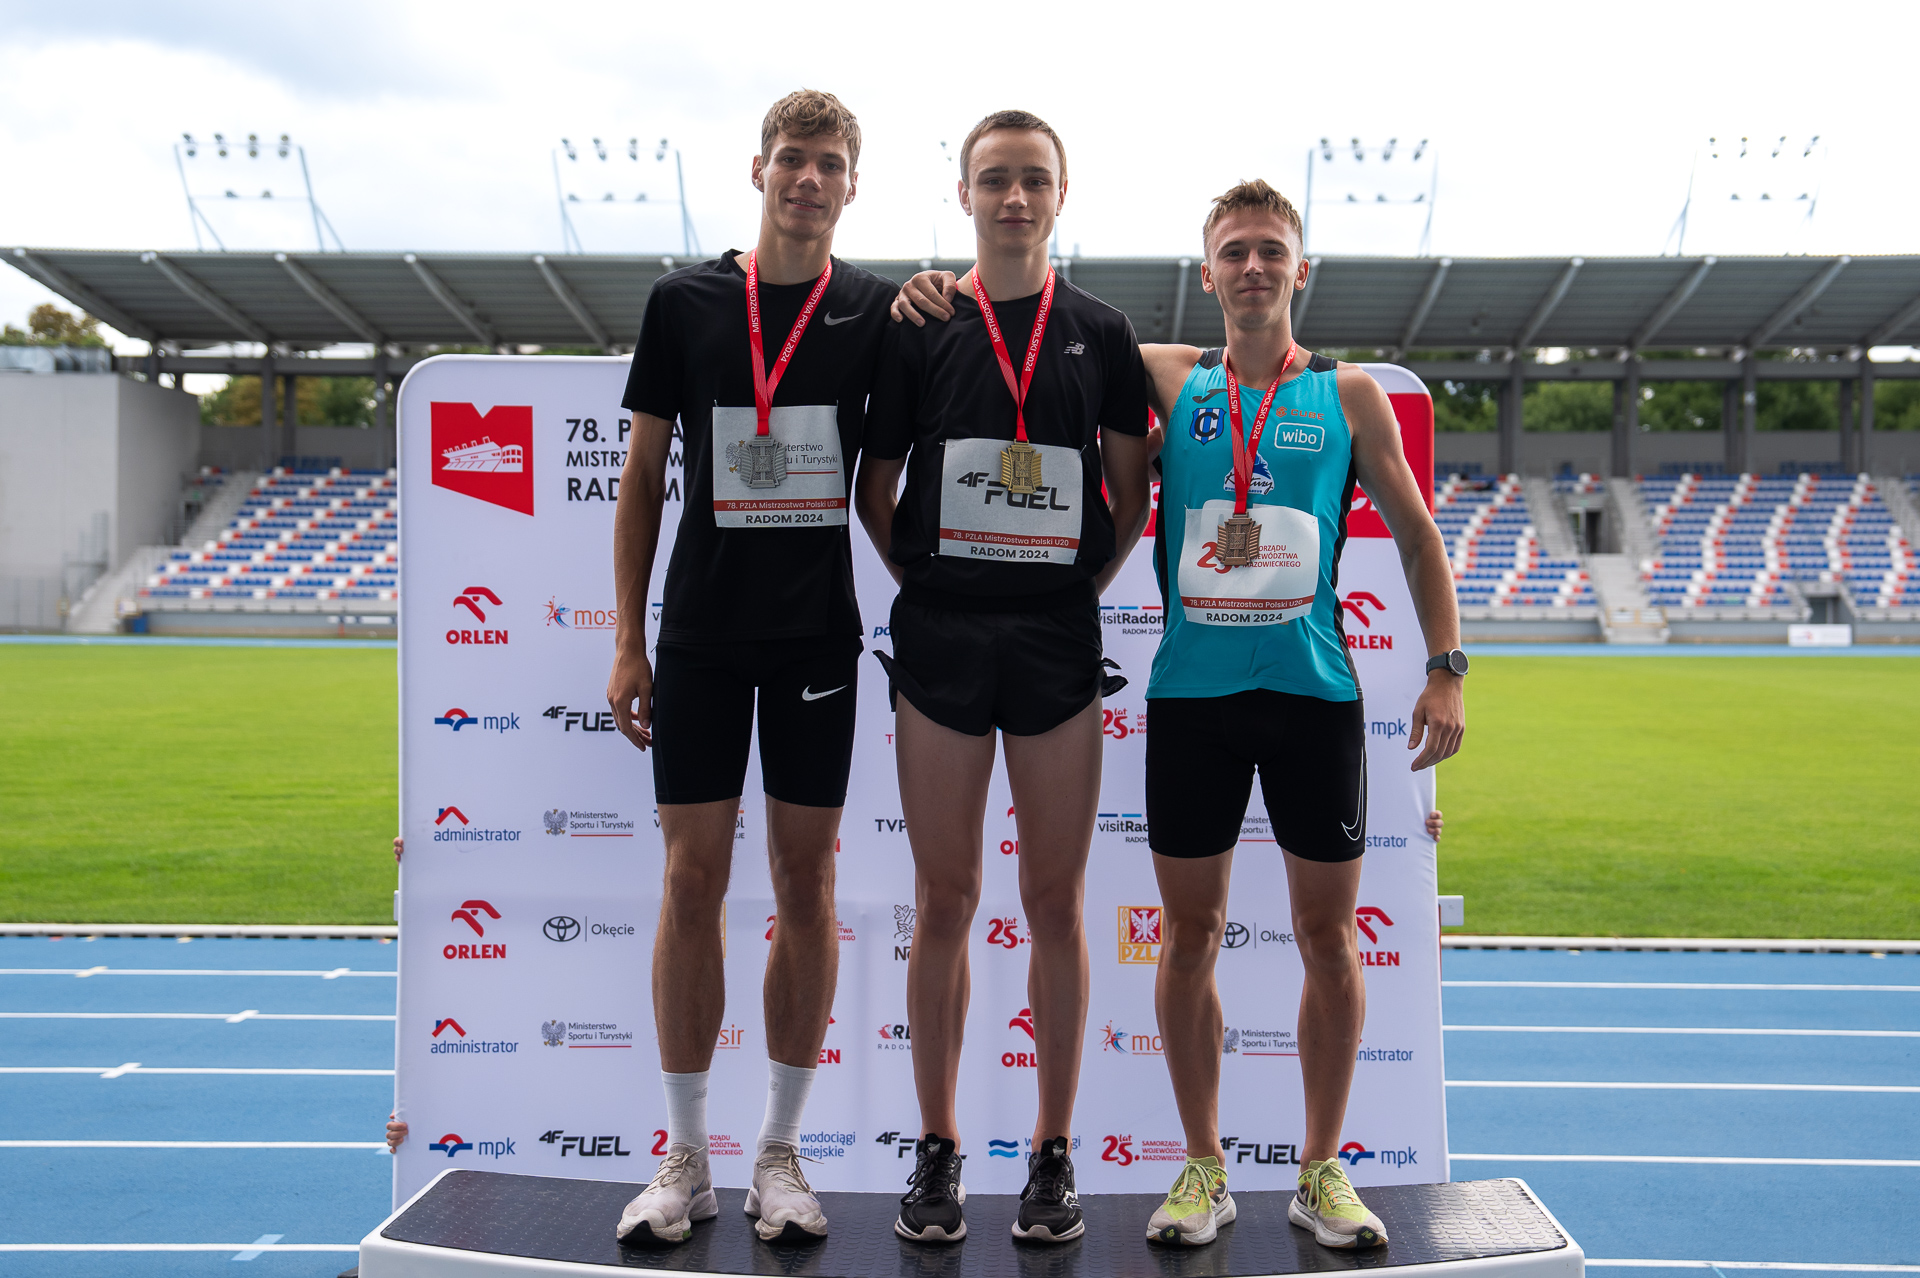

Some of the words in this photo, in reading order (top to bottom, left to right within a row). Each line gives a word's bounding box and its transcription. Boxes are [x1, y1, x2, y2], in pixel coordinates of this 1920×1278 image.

[749, 273, 760, 333] MISTRZOSTWA
[977, 288, 1001, 342] MISTRZOSTWA
[788, 314, 808, 342] POLSKI
[1029, 322, 1043, 352] POLSKI
[780, 341, 795, 362] 2024
[1024, 351, 1035, 372] 2024
[1291, 408, 1325, 420] CUBE
[566, 418, 606, 442] 78.
[1252, 420, 1263, 440] 2024
[1282, 429, 1317, 444] wibo
[801, 454, 838, 466] Turystyki
[957, 472, 990, 488] 4F
[984, 480, 1070, 511] FUEL
[740, 502, 758, 510] PZLA
[806, 500, 826, 508] Polski
[827, 500, 838, 508] U20
[746, 514, 792, 524] RADOM
[795, 514, 824, 523] 2024
[984, 534, 1030, 544] Mistrzostwa
[1031, 538, 1053, 546] Polski
[970, 546, 1016, 558] RADOM
[1019, 550, 1050, 560] 2024
[1218, 600, 1264, 608] Mistrzostwa
[574, 610, 617, 626] mos
[1206, 613, 1250, 623] RADOM
[1253, 613, 1283, 622] 2024
[446, 630, 508, 644] ORLEN
[1346, 635, 1392, 650] RLEN
[484, 712, 520, 734] mpk
[542, 706, 567, 718] 4F
[565, 712, 619, 732] FUE
[1372, 718, 1407, 739] mpk
[570, 812, 618, 820] Ministerstwo
[1243, 816, 1268, 824] inister
[570, 821, 595, 830] Sportu
[601, 820, 634, 830] Turystyki
[434, 828, 522, 842] administrator
[1366, 835, 1408, 848] strator
[591, 924, 635, 938] Okęcie
[987, 918, 1025, 949] 25.
[1260, 930, 1296, 944] Okęc
[443, 944, 507, 960] ORLEN
[1358, 952, 1400, 966] RLEN
[568, 1022, 617, 1030] Ministerstwo
[568, 1032, 593, 1042] Sportu
[600, 1032, 633, 1041] Turystyki
[719, 1024, 744, 1045] sir
[1242, 1030, 1291, 1038] Ministerstwo
[430, 1040, 518, 1054] administrator
[1242, 1040, 1267, 1048] Sportu
[1273, 1040, 1298, 1049] Turyst
[1002, 1052, 1038, 1068] ORL
[1356, 1047, 1414, 1061] nistrator
[539, 1130, 564, 1144] 4F
[562, 1136, 631, 1156] FUEL
[708, 1134, 730, 1142] RZĄDU
[800, 1131, 856, 1146] wodociągi
[876, 1132, 900, 1144] 4F
[1119, 1133, 1132, 1143] lat
[1142, 1140, 1182, 1148] SAMORZĄDU
[479, 1137, 516, 1160] mpk
[800, 1146, 844, 1159] miejskie
[1101, 1134, 1140, 1166] 25.
[1142, 1146, 1188, 1154] WOJEWÓDZTW
[1381, 1146, 1418, 1168] mpk
